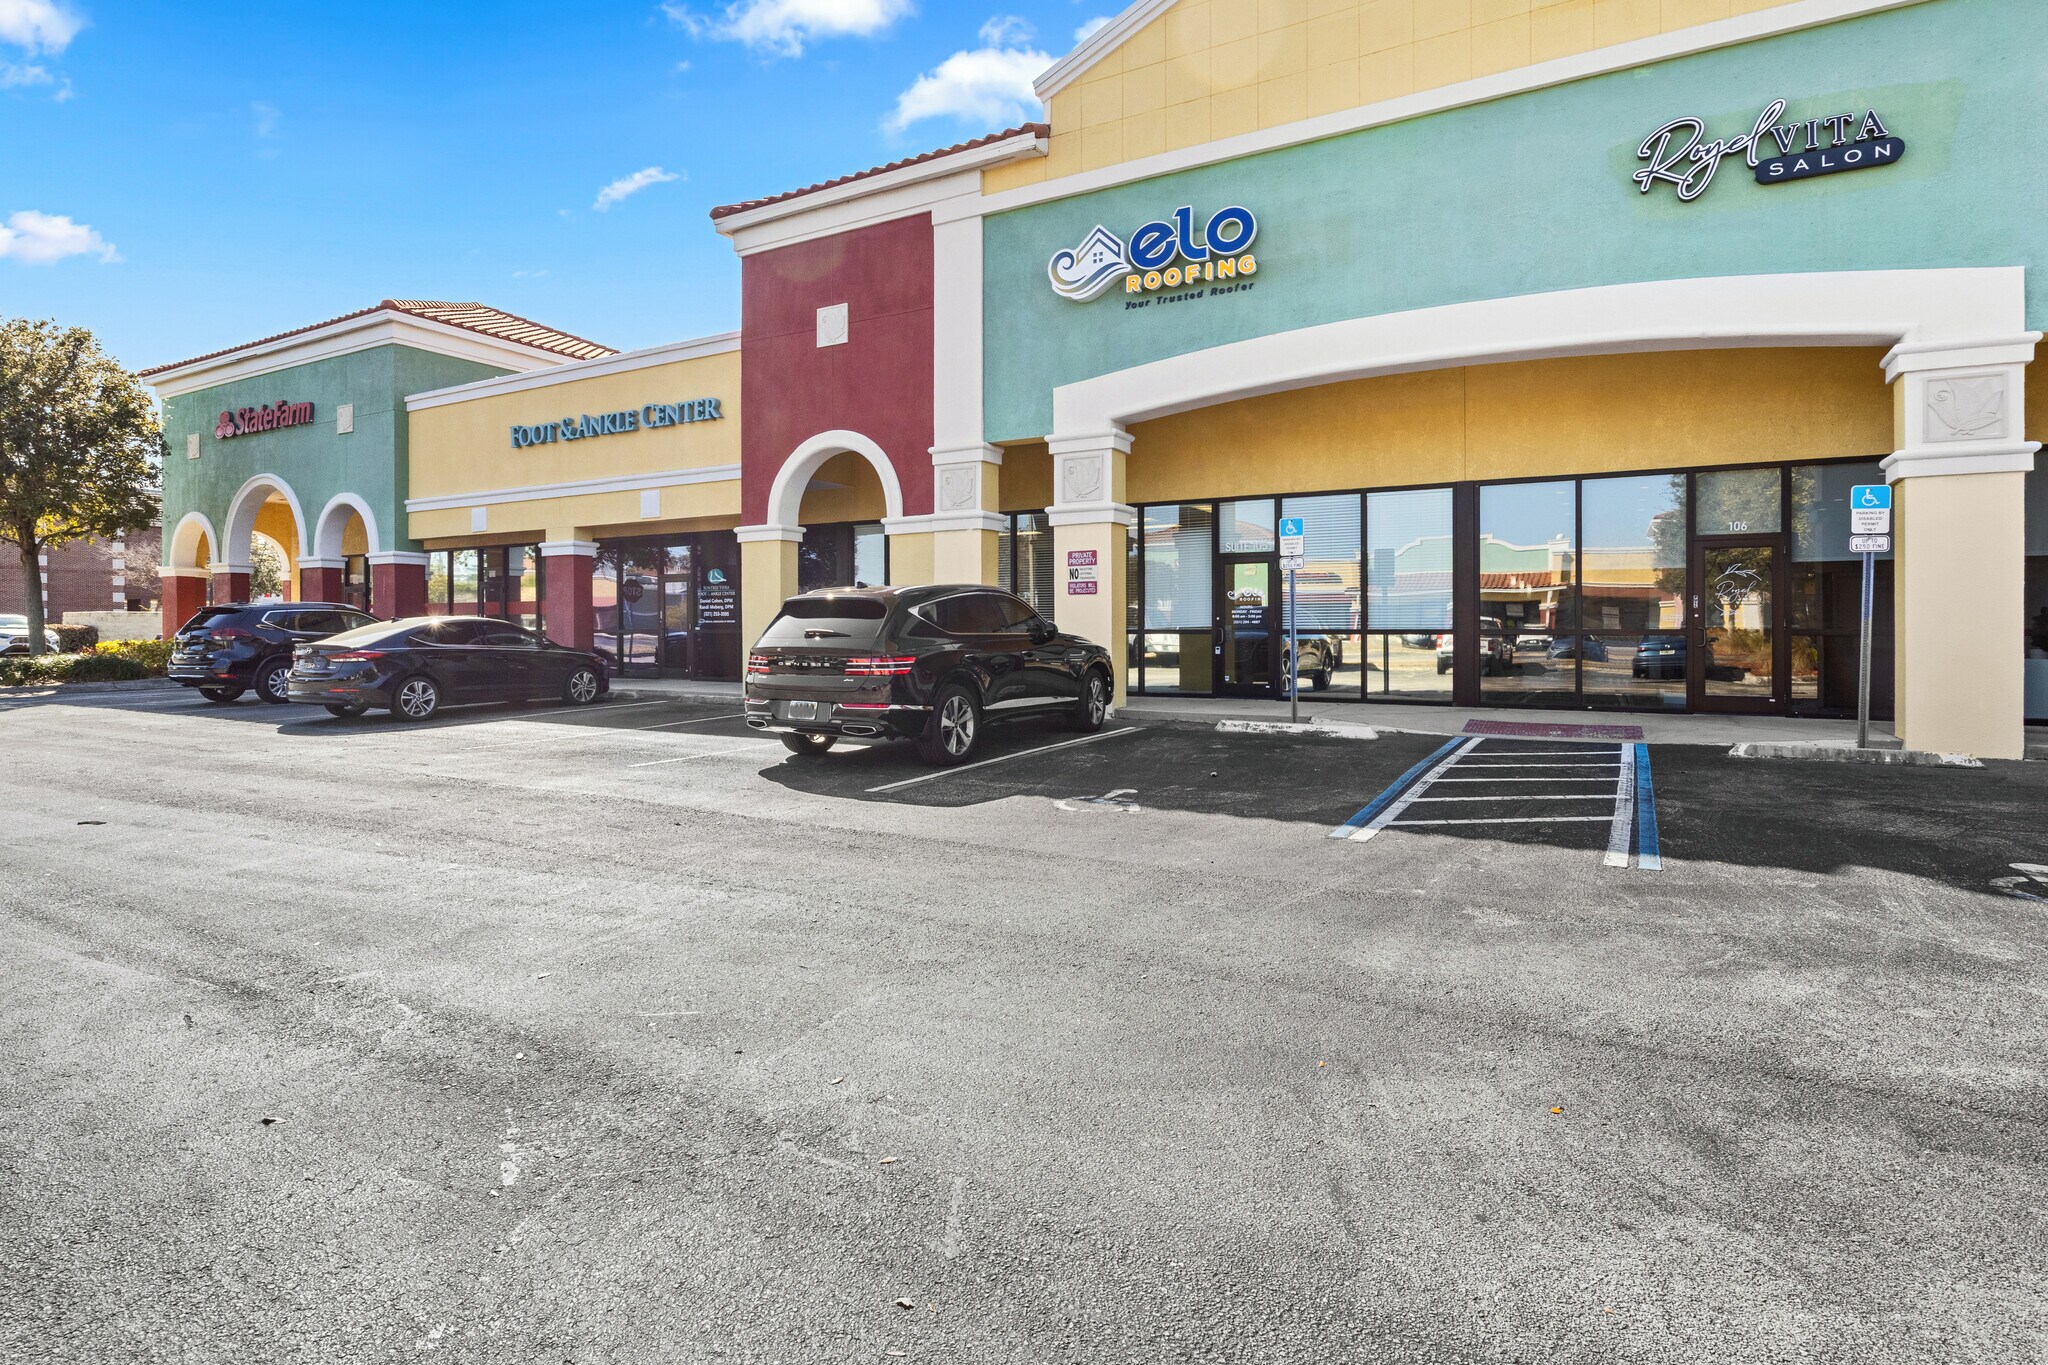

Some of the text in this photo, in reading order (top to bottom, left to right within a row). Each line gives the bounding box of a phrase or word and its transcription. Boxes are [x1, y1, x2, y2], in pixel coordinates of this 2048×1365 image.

[1770, 108, 1888, 153] VITA
[1769, 144, 1891, 176] SALON
[1126, 255, 1258, 293] ROOFING
[1156, 289, 1204, 305] Trusted
[1210, 281, 1254, 297] Roofer
[510, 422, 558, 448] FOOT
[575, 409, 639, 438] ANKLE
[640, 397, 723, 429] CENTER
[1728, 521, 1747, 531] 106
[1225, 541, 1268, 552] SUITE 105
[1069, 568, 1079, 580] NO
